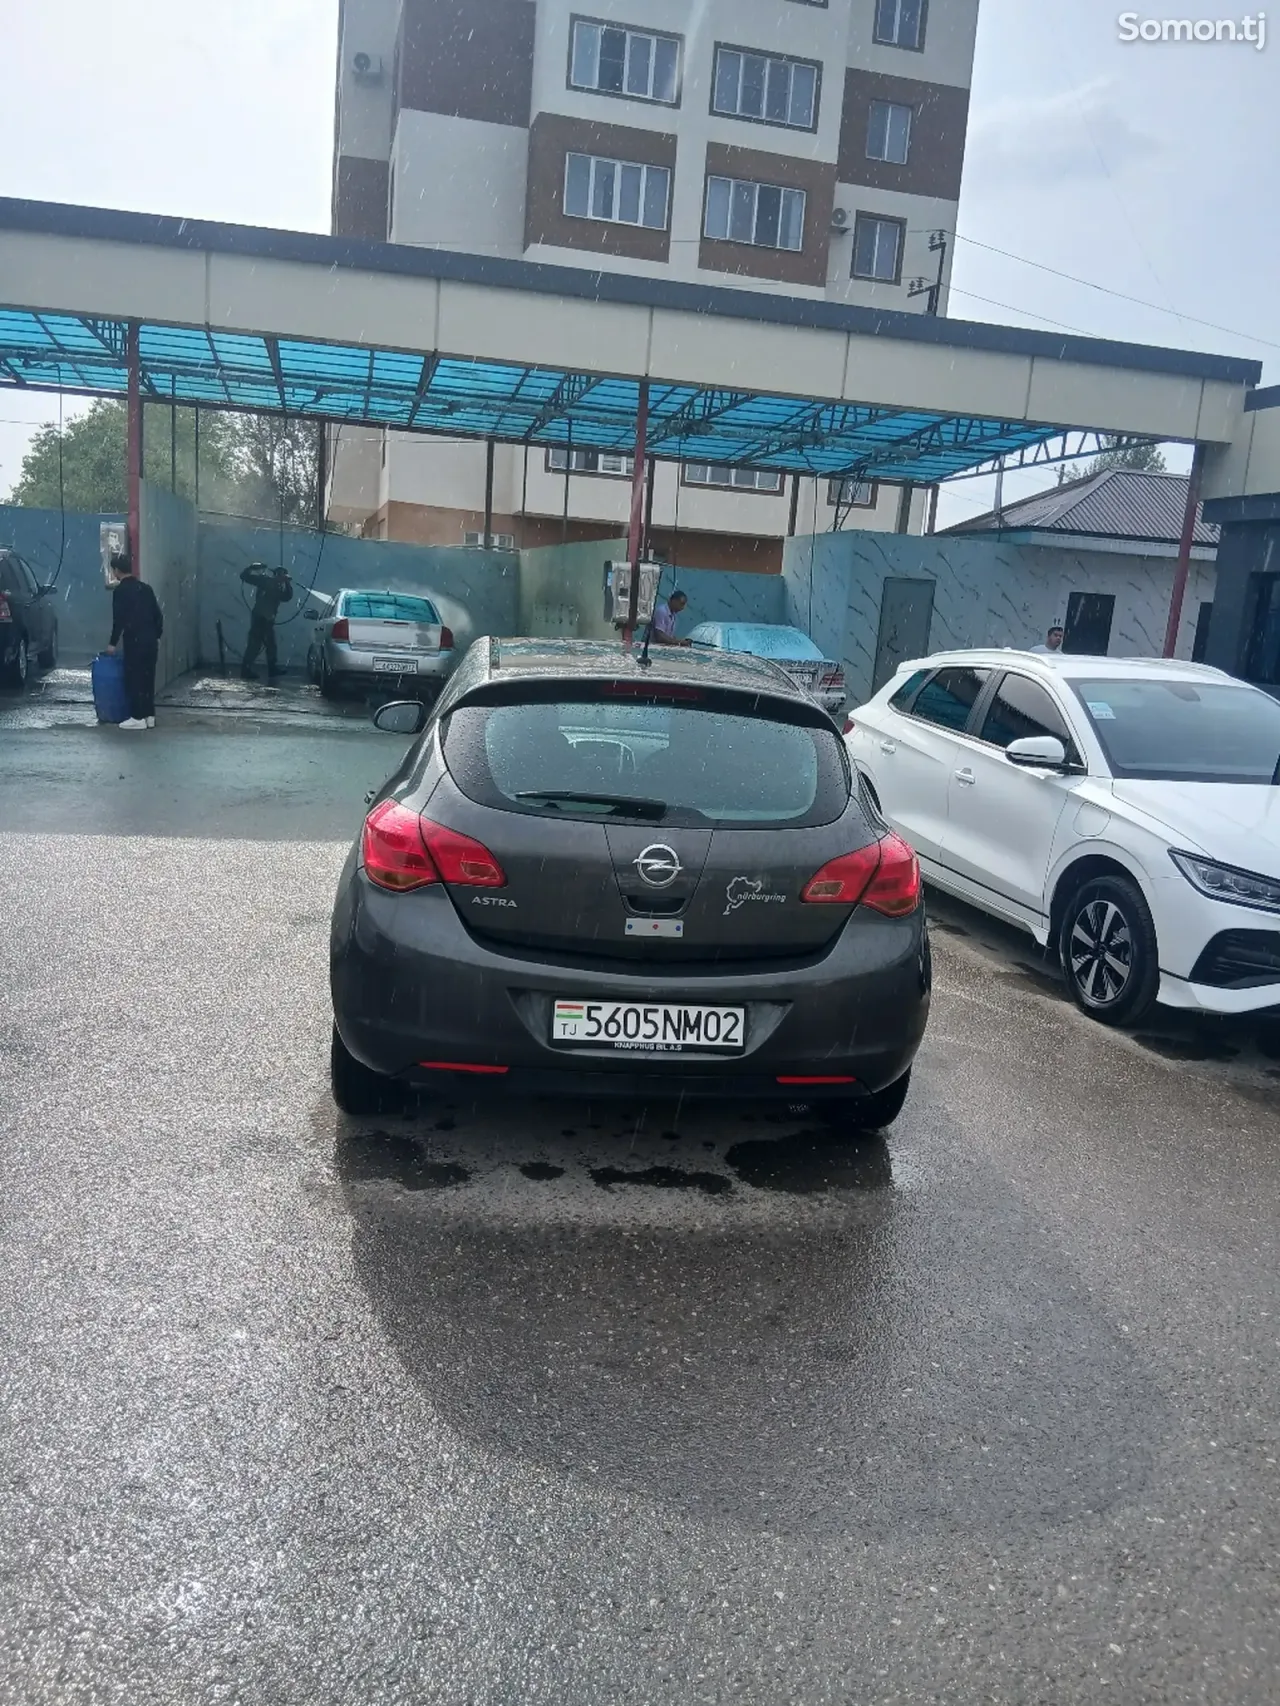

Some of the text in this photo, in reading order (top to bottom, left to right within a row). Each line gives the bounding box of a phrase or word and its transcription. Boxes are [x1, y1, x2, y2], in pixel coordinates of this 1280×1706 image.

[471, 896, 518, 908] ASTRA
[561, 1023, 577, 1036] TJ
[585, 1005, 740, 1043] 5605NM02
